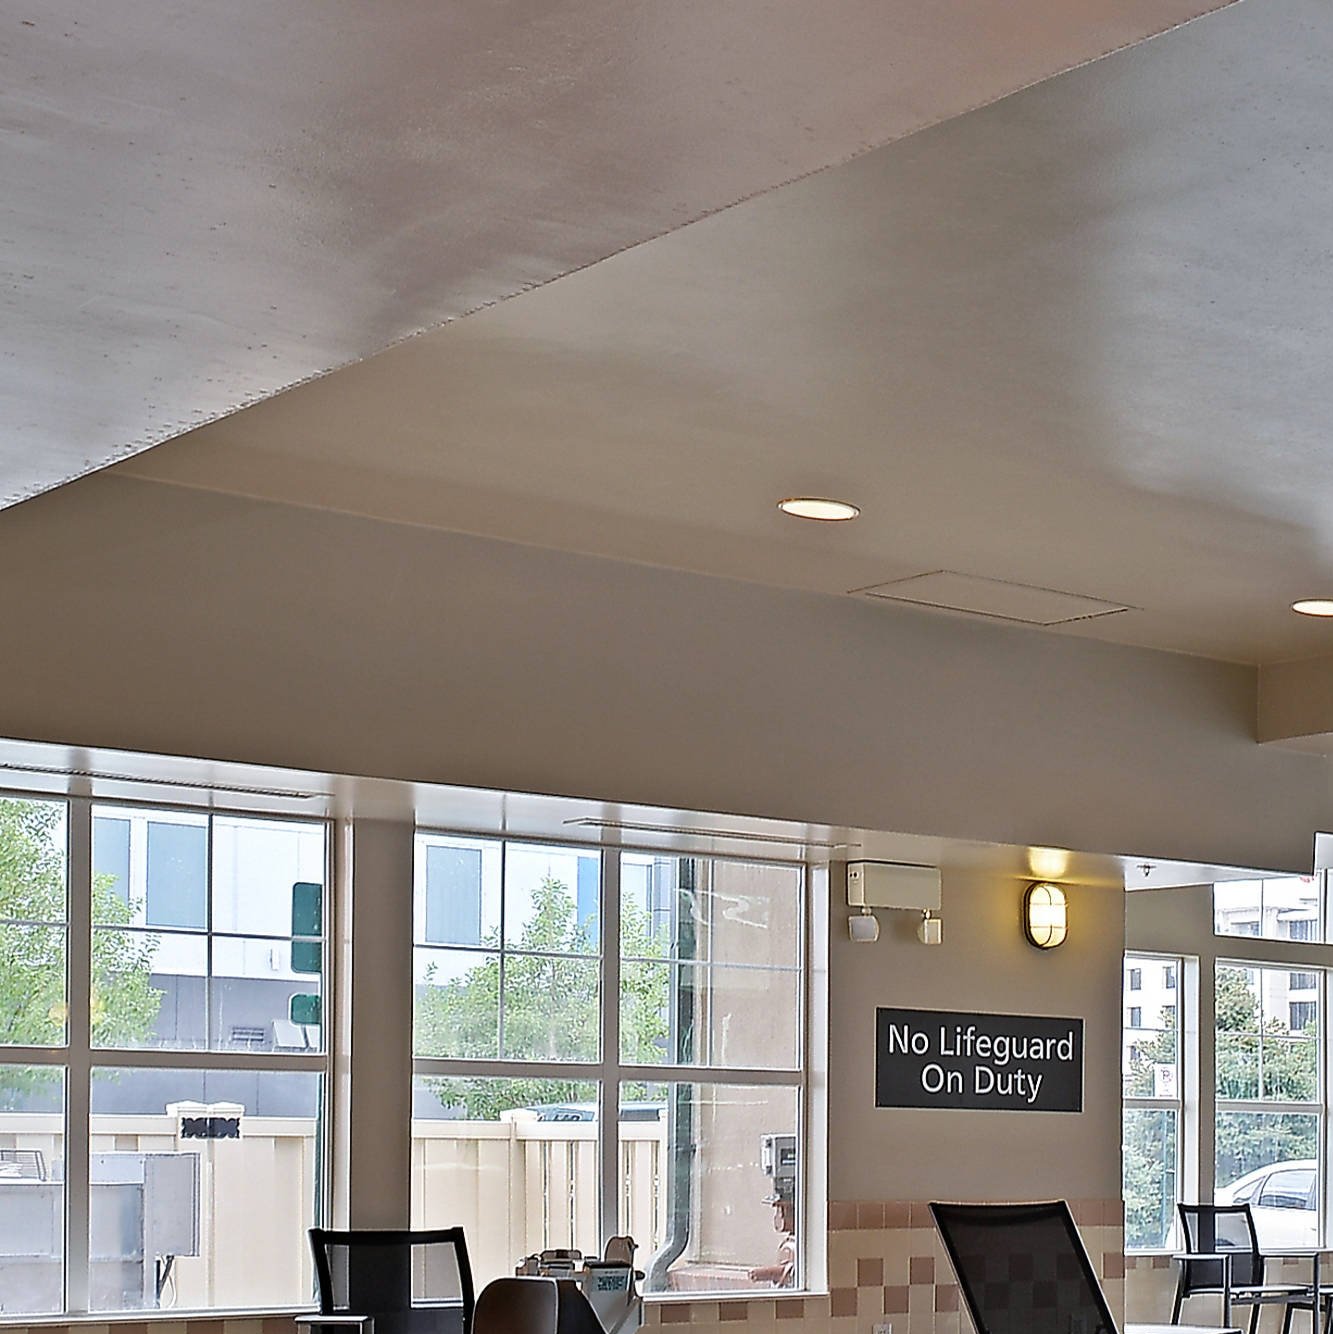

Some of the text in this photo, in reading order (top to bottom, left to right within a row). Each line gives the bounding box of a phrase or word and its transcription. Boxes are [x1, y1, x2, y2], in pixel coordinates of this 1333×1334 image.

[889, 1024, 1073, 1065] No Lifeguard
[921, 1063, 1042, 1103] On Duty
